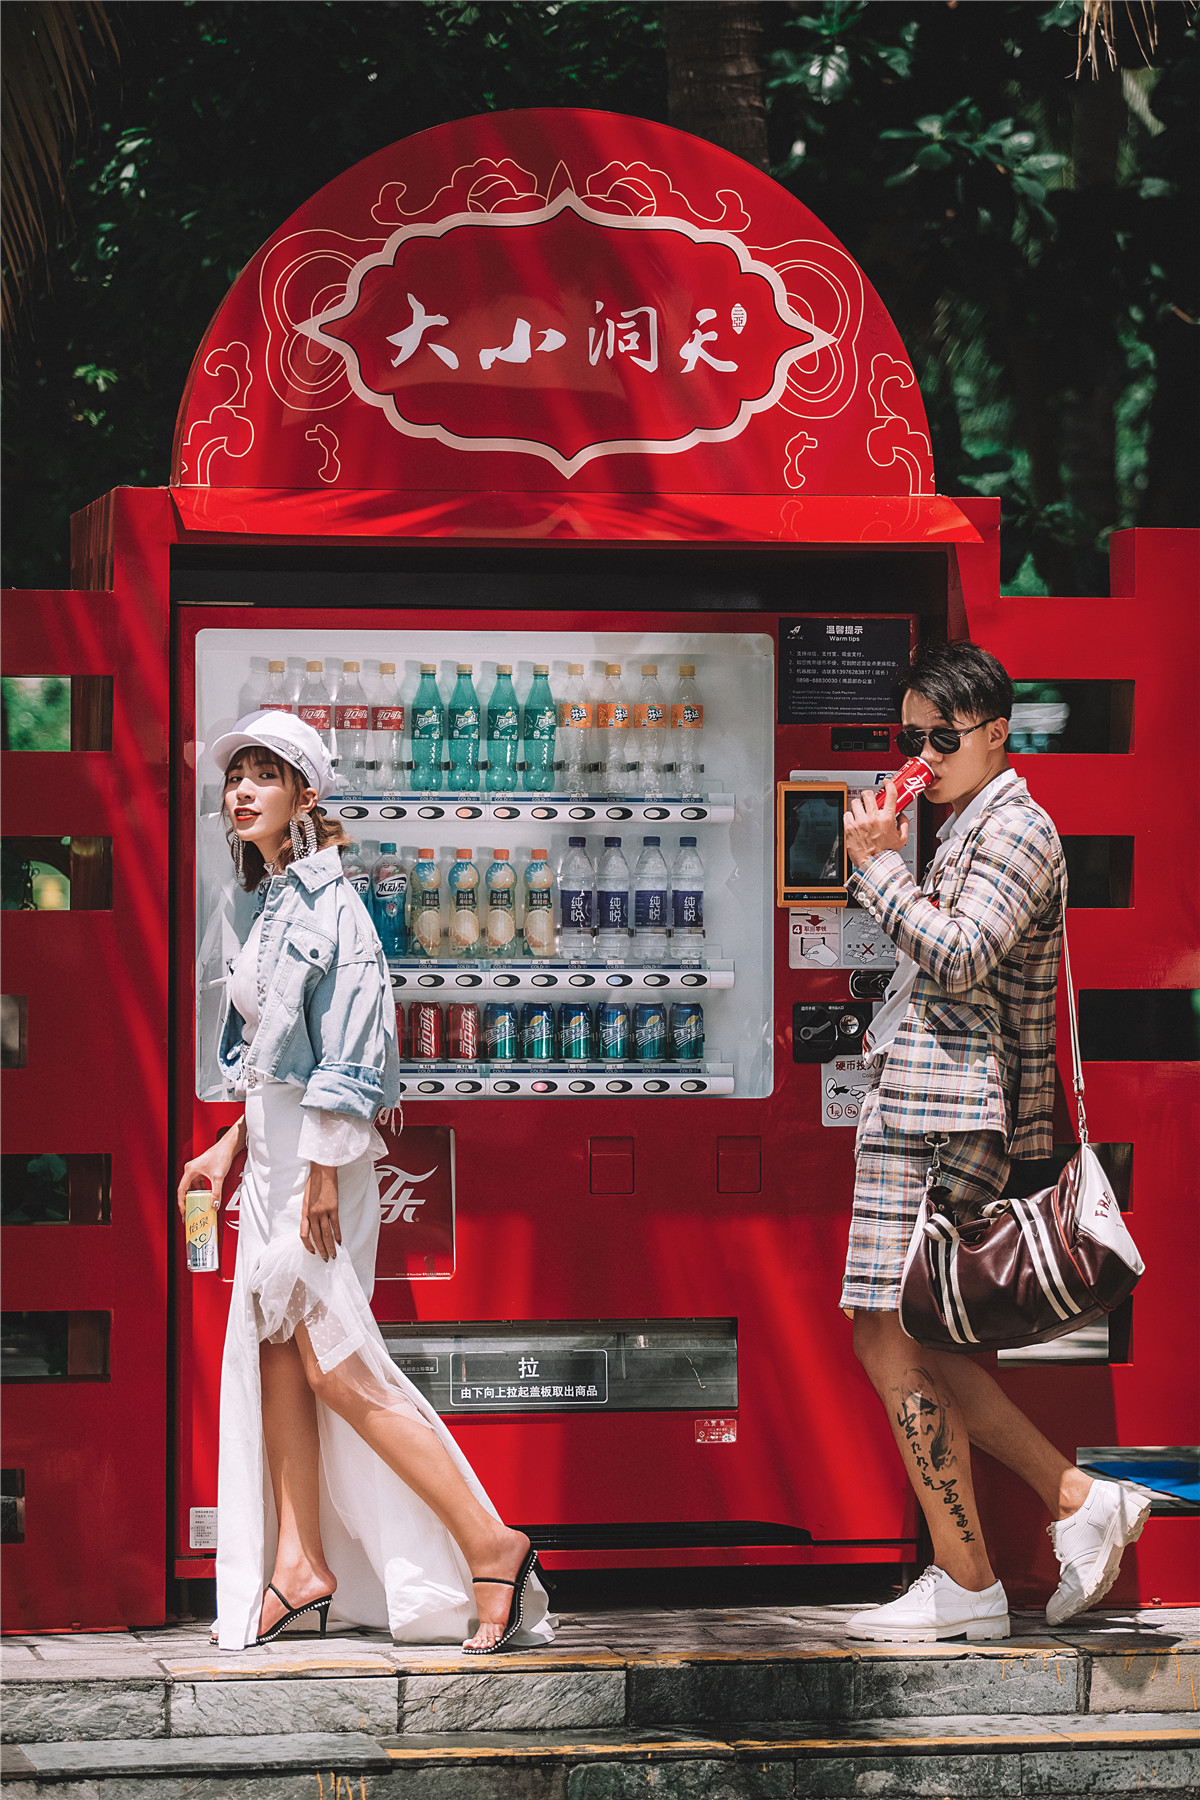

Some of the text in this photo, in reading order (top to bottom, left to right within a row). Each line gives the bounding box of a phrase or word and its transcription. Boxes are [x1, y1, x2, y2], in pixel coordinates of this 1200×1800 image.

[385, 292, 739, 374] 大小洞天
[825, 625, 864, 635] 温馨提示
[848, 635, 860, 643] tips
[570, 896, 585, 923] 纯悦
[609, 896, 622, 923] 纯悦
[648, 895, 661, 921] 纯悦
[683, 895, 697, 922] 纯悦
[793, 925, 801, 934] 4
[518, 1356, 540, 1379] 拉
[461, 1385, 598, 1399] 由下向上拉起盖板取出商品
